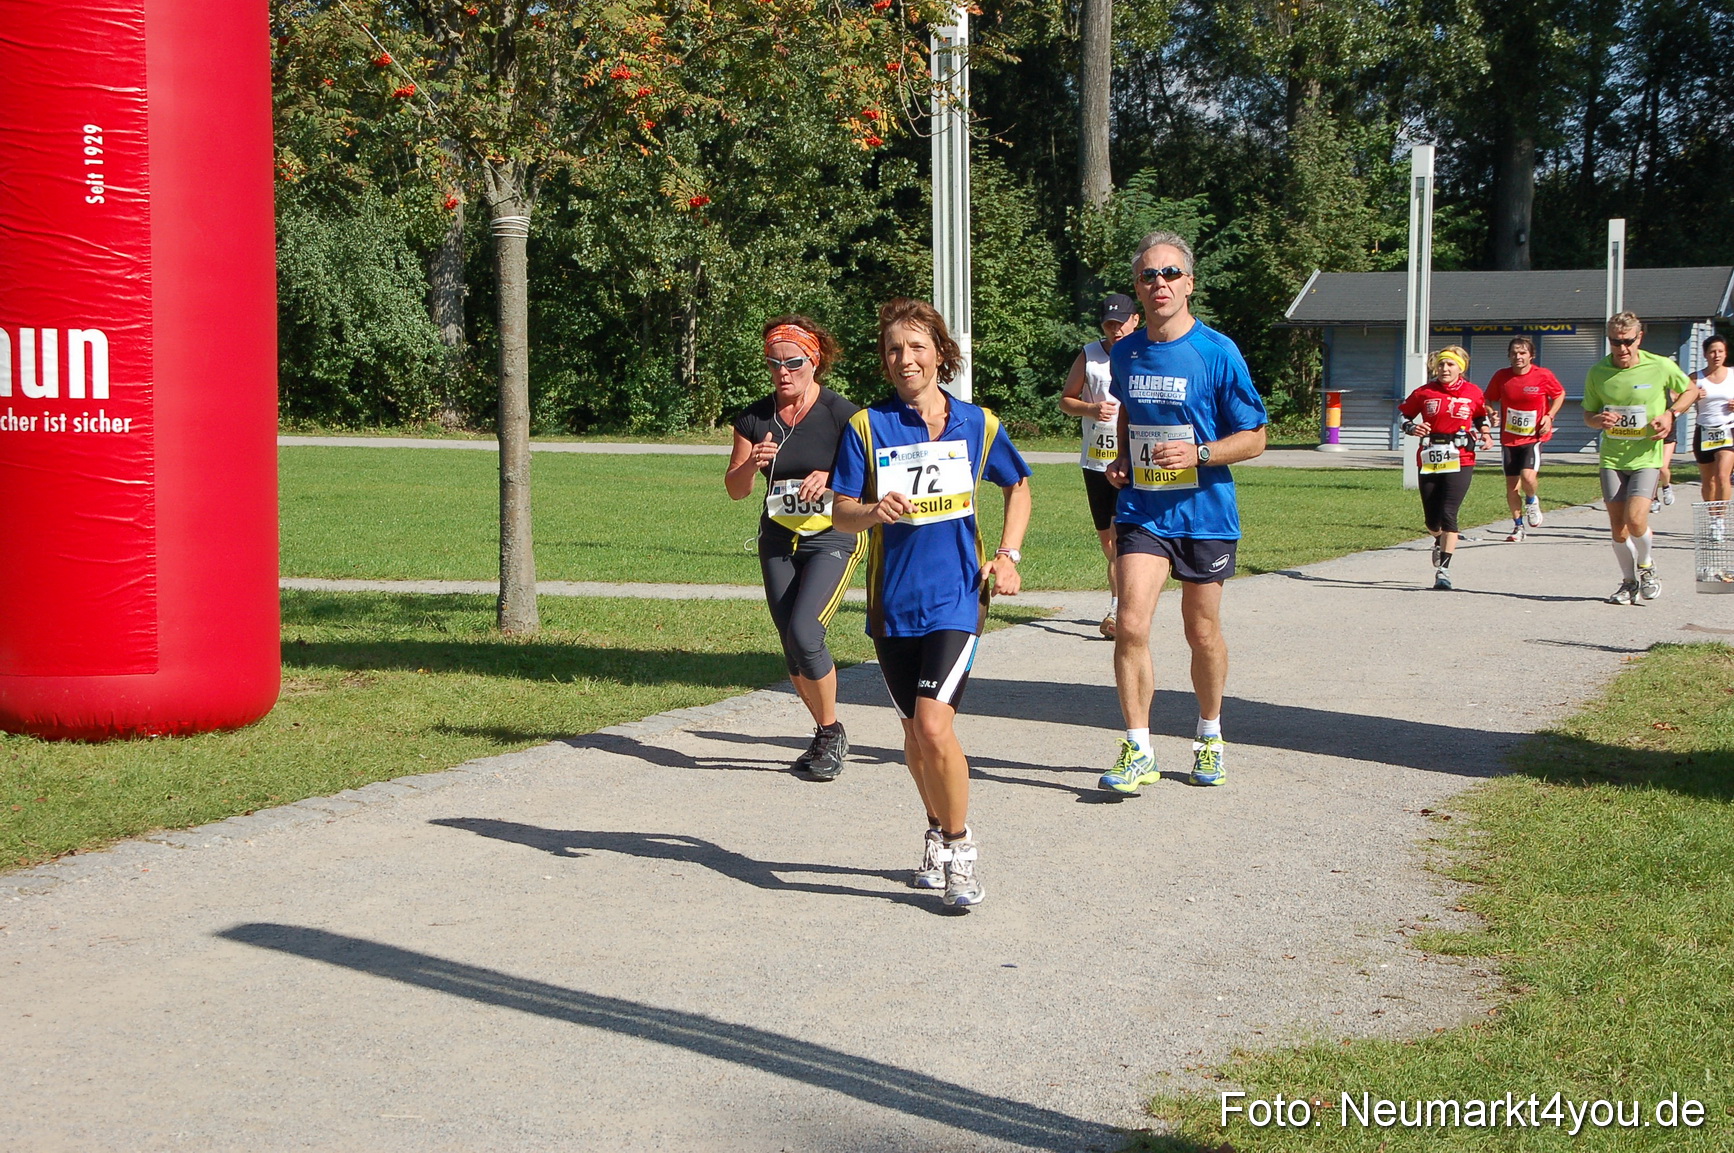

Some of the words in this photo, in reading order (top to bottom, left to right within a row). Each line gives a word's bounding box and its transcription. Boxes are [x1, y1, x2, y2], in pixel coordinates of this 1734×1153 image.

[83, 124, 104, 165] 1929
[85, 173, 105, 204] Seit
[1129, 375, 1188, 392] HUBER
[0, 407, 38, 432] cher
[43, 411, 67, 432] ist
[73, 409, 133, 433] sicher
[1512, 415, 1529, 427] 666
[1611, 427, 1641, 436] Joachim
[1096, 434, 1118, 449] 45
[1429, 450, 1451, 463] 654
[907, 464, 943, 495] 72
[1144, 468, 1177, 482] Klaus
[782, 493, 825, 514] 953
[904, 496, 952, 514] rsula
